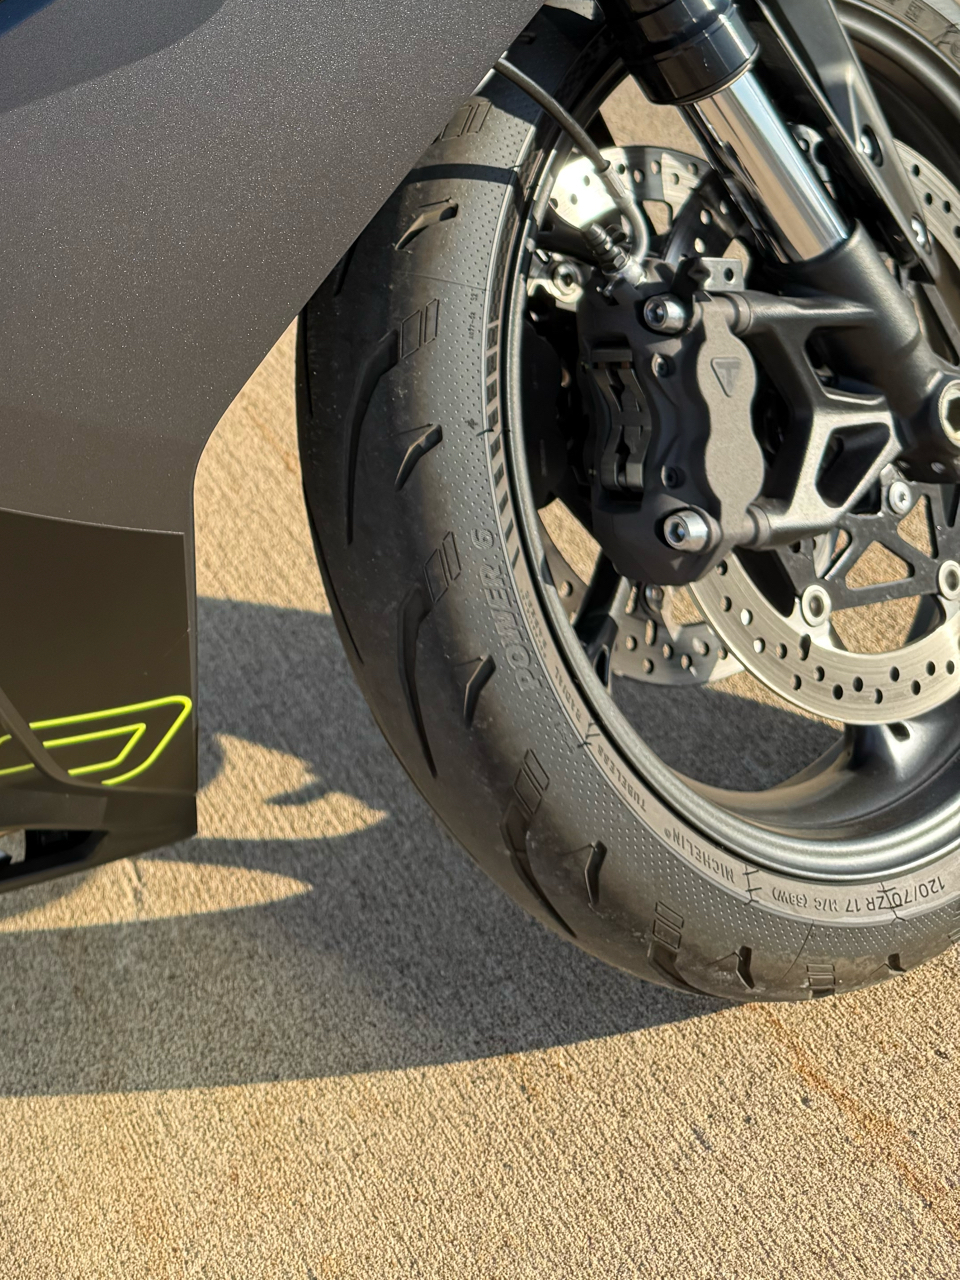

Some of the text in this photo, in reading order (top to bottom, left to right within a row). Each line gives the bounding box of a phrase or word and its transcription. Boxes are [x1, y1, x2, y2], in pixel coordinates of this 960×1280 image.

[471, 528, 494, 550] 6
[480, 564, 543, 692] POWER
[554, 665, 582, 723] RADIAL
[597, 744, 648, 813] TUBELESS
[845, 898, 862, 913] 17
